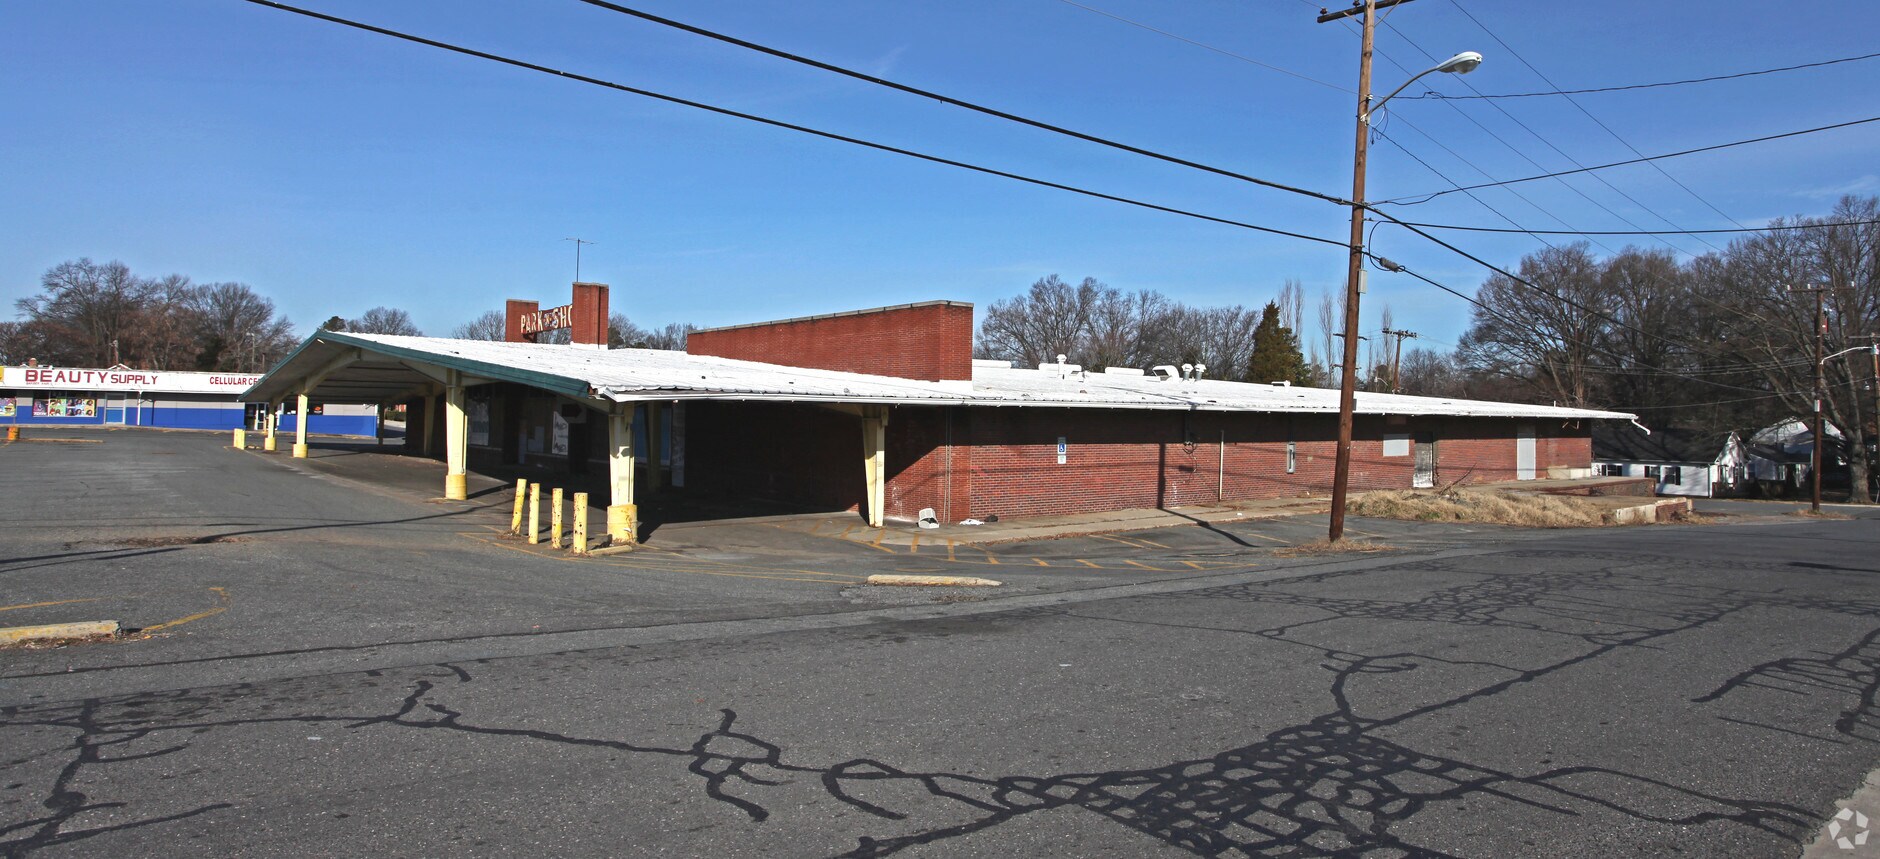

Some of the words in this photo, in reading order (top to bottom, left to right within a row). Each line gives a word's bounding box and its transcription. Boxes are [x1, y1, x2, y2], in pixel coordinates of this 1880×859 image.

[520, 311, 543, 333] PARK
[25, 370, 108, 383] BEAUTY
[111, 374, 158, 385] SUPPLY
[209, 376, 247, 385] CELLULAR
[248, 377, 260, 386] CE
